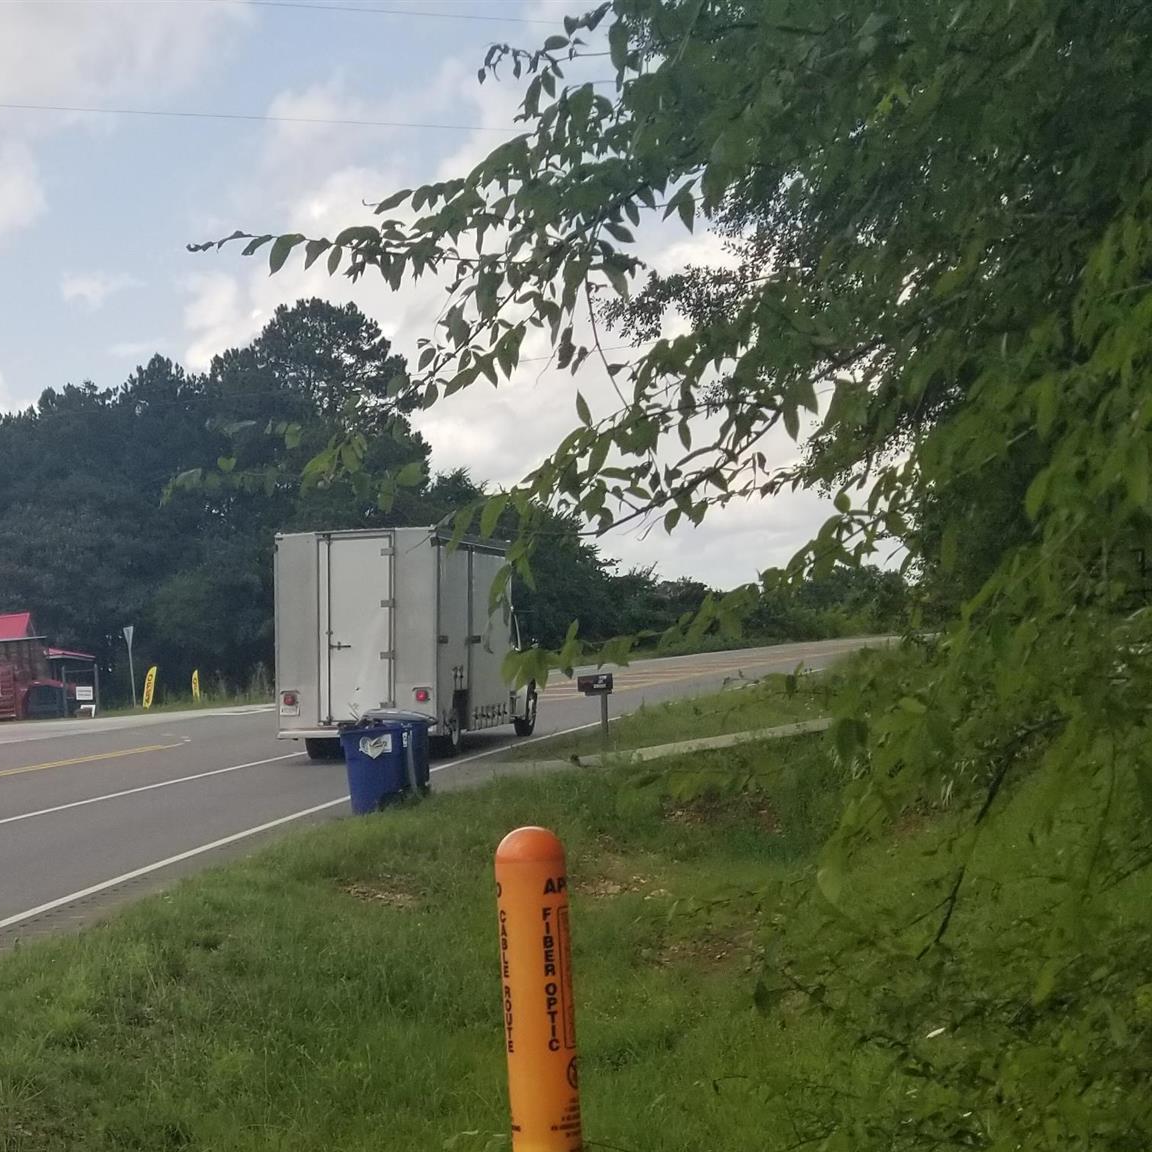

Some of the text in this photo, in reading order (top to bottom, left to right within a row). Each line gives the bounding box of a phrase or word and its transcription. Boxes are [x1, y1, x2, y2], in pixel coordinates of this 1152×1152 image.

[499, 910, 514, 1053] CABLE ROUTE
[542, 907, 560, 1051] FIBER OPTIC
